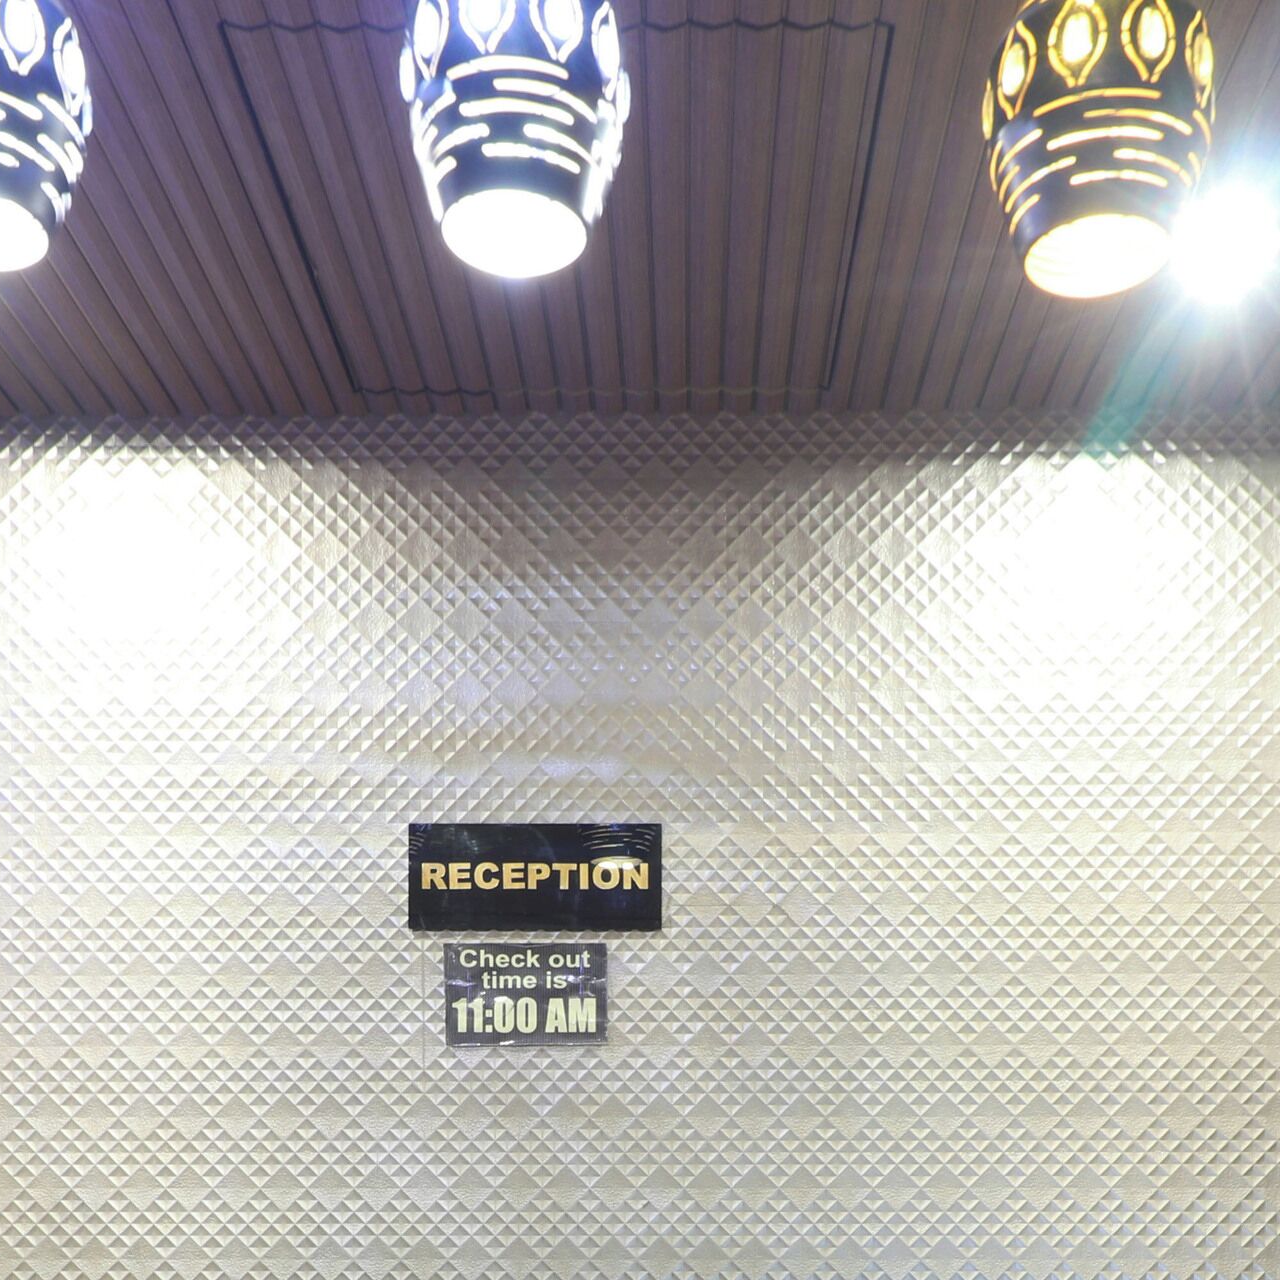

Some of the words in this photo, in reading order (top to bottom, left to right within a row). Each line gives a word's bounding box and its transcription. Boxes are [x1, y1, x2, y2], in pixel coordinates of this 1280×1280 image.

[420, 861, 650, 891] RECEPTION
[459, 949, 541, 968] Check
[548, 950, 591, 968] out
[481, 971, 538, 989] time
[546, 971, 568, 989] is
[451, 996, 538, 1034] 11:00
[545, 997, 597, 1034] AM
